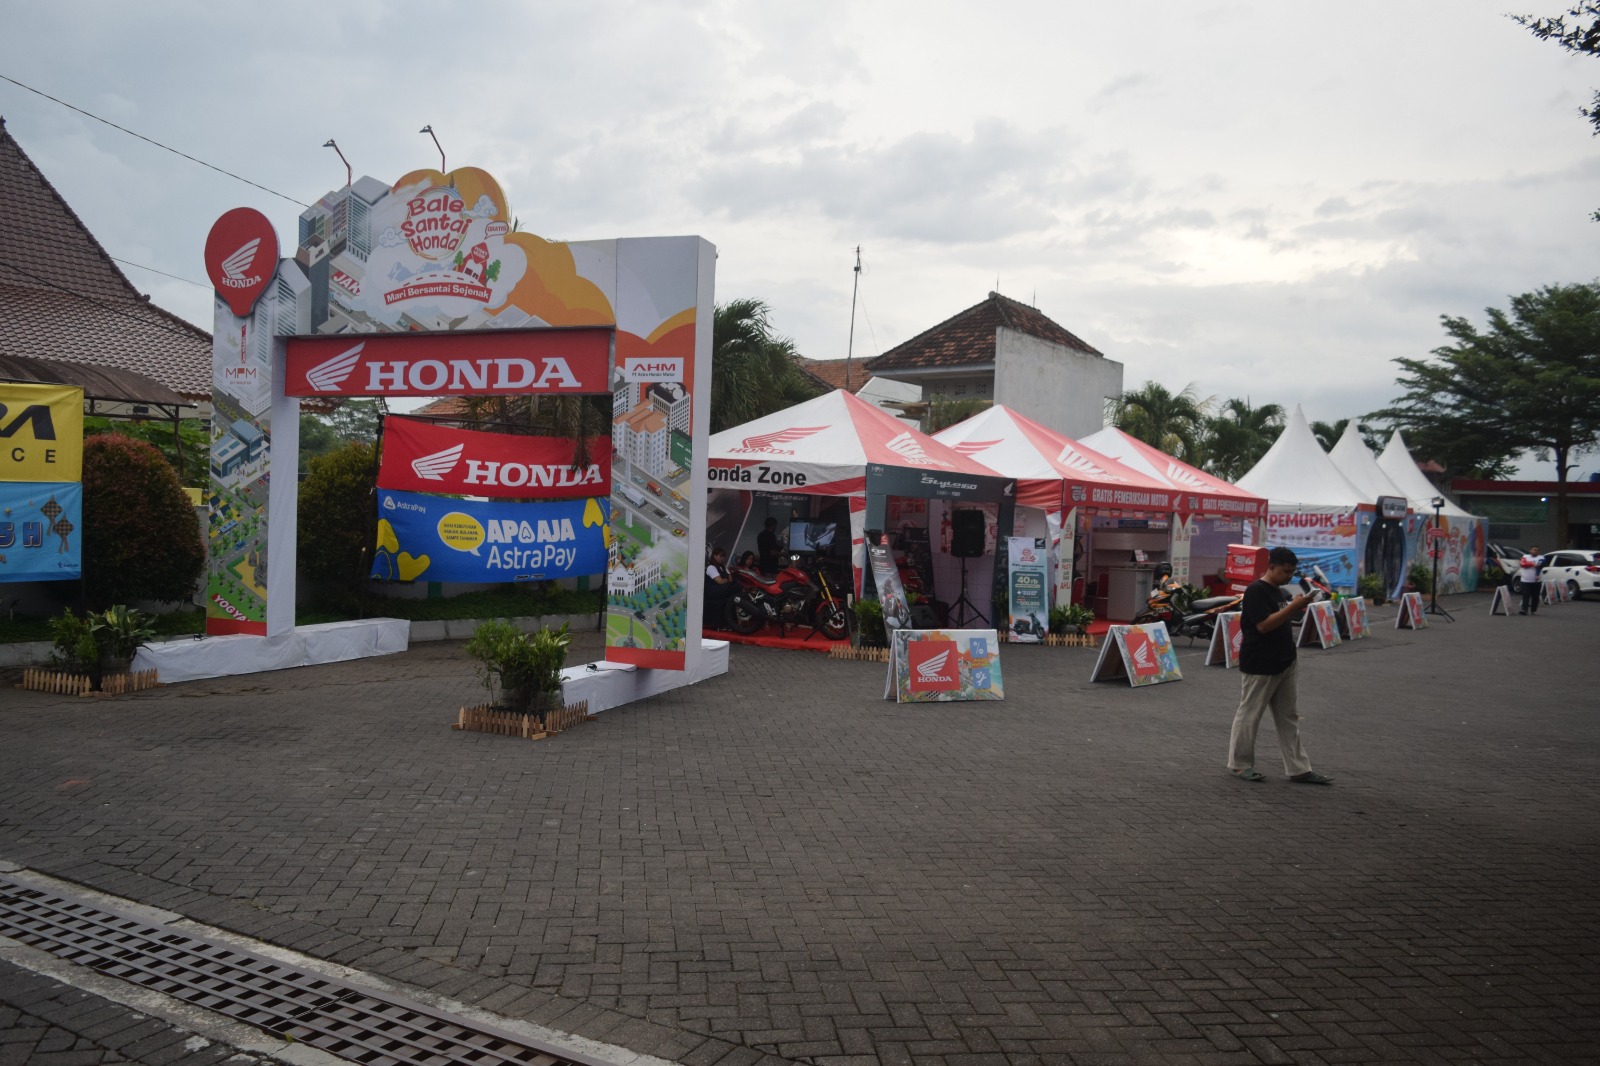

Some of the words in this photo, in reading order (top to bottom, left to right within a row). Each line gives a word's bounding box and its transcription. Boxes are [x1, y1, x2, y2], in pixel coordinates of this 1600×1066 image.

[407, 195, 464, 216] Bale
[401, 214, 473, 238] Santai
[411, 233, 460, 253] Honda
[221, 275, 262, 289] HONDA
[386, 290, 407, 303] Mari
[407, 285, 451, 296] Bersantai
[452, 284, 489, 299] Sejenak
[226, 368, 256, 379] MPM
[365, 357, 582, 391] HONDA
[632, 363, 676, 372] AHM
[727, 447, 795, 456] HONDA
[463, 459, 603, 487] HONDA
[708, 465, 751, 483] onda
[757, 466, 807, 486] Zone
[1092, 488, 1113, 504] GRATIS
[1113, 490, 1150, 506] PEMERIKSAAN
[1150, 493, 1169, 507] MOTOR
[1202, 498, 1217, 511] GRATIS
[1217, 499, 1245, 513] PEMERIKSAAN
[1245, 501, 1257, 513] MOTOR
[397, 501, 427, 514] AstraPay
[1269, 513, 1335, 528] PEMUDIK
[486, 544, 577, 571] AstraPay
[1017, 576, 1030, 585] 40
